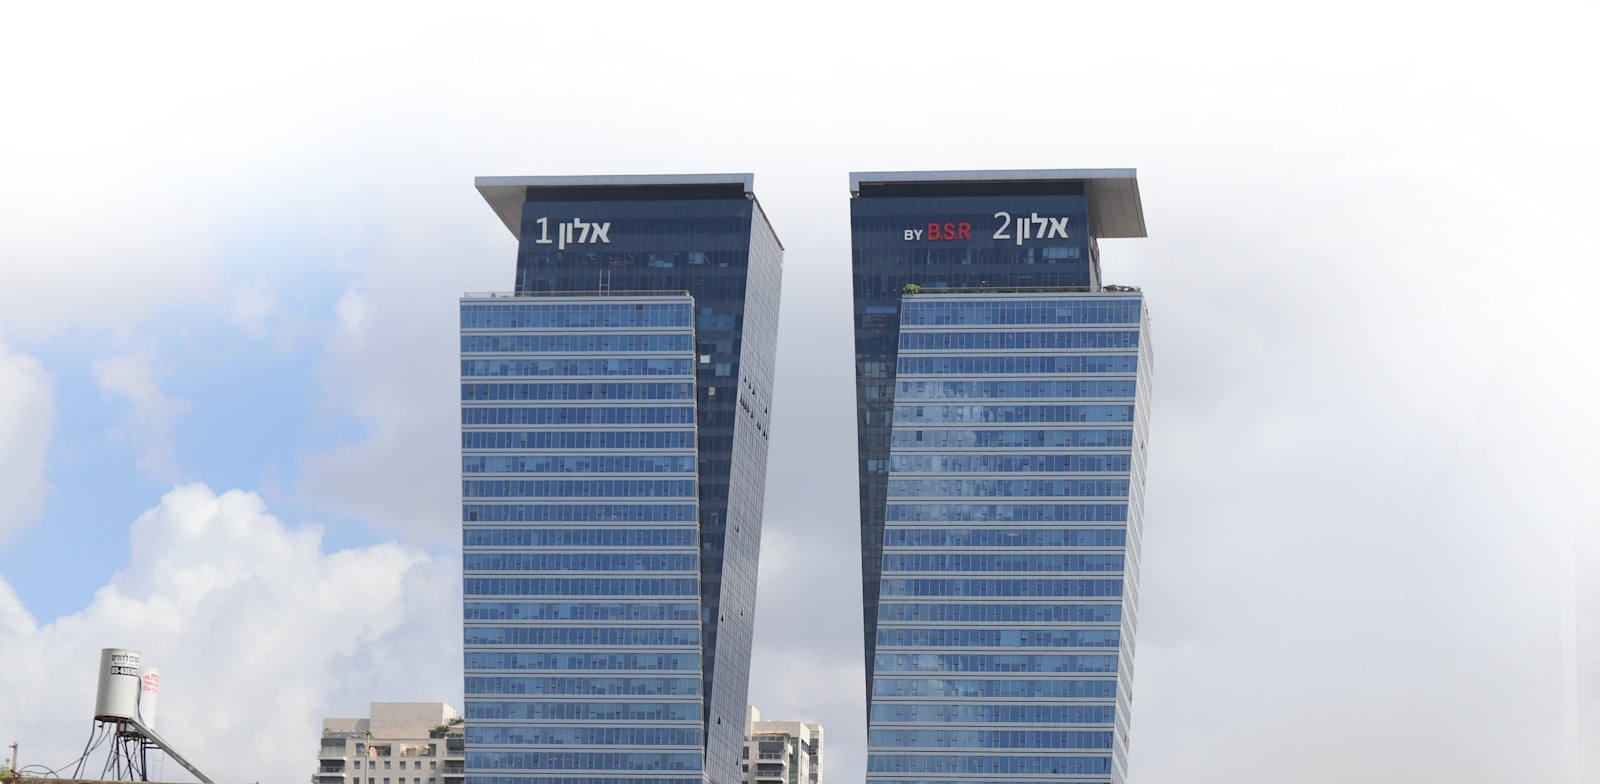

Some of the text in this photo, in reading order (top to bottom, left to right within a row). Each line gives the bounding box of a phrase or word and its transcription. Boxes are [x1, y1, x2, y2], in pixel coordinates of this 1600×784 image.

[535, 216, 611, 250] אלון 1
[904, 222, 971, 241] BY B.S.R
[993, 211, 1069, 245] אלון 2
